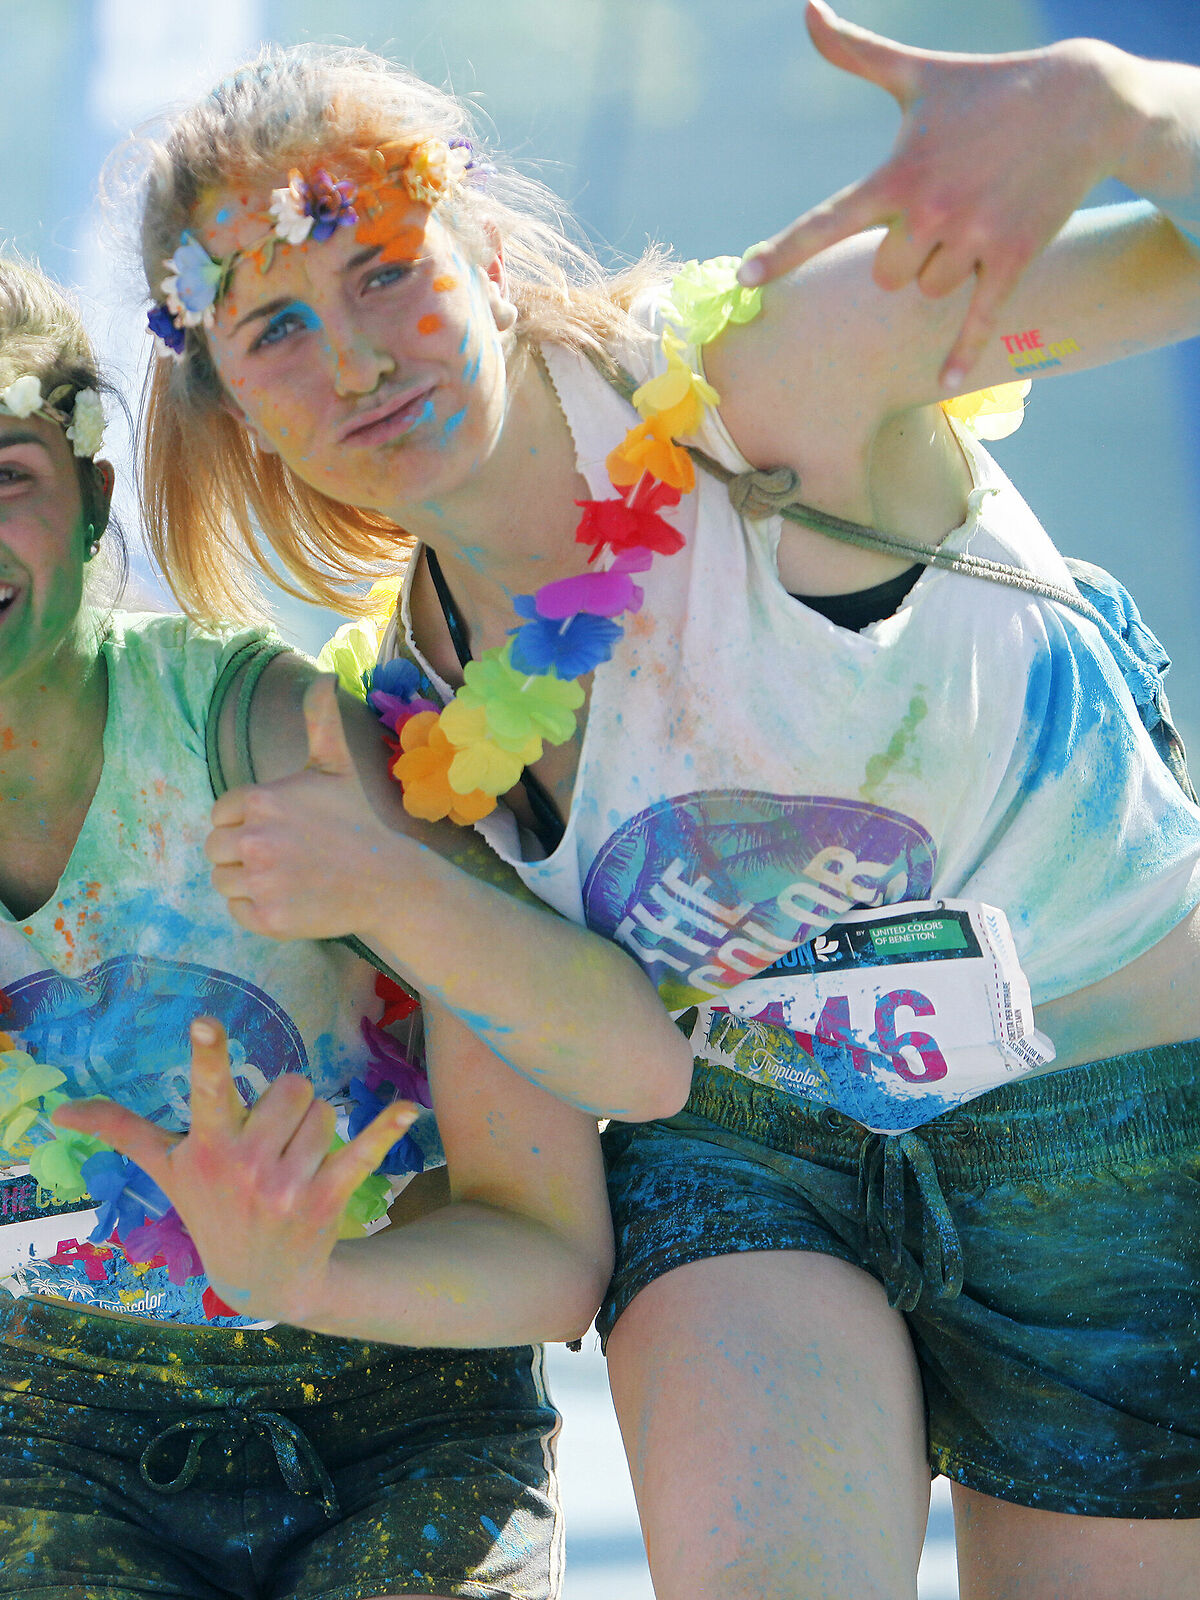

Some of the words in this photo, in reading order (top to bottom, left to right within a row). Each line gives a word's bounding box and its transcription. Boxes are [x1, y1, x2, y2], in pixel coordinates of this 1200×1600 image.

[1000, 329, 1045, 354] THE
[1008, 337, 1080, 368] COLOR
[613, 857, 754, 973] THE
[687, 845, 891, 996] COLOR
[767, 940, 816, 969] UN
[871, 926, 906, 937] UNITED
[907, 921, 944, 932] COLORS
[874, 936, 888, 945] OF
[888, 932, 937, 944] BENETTON.
